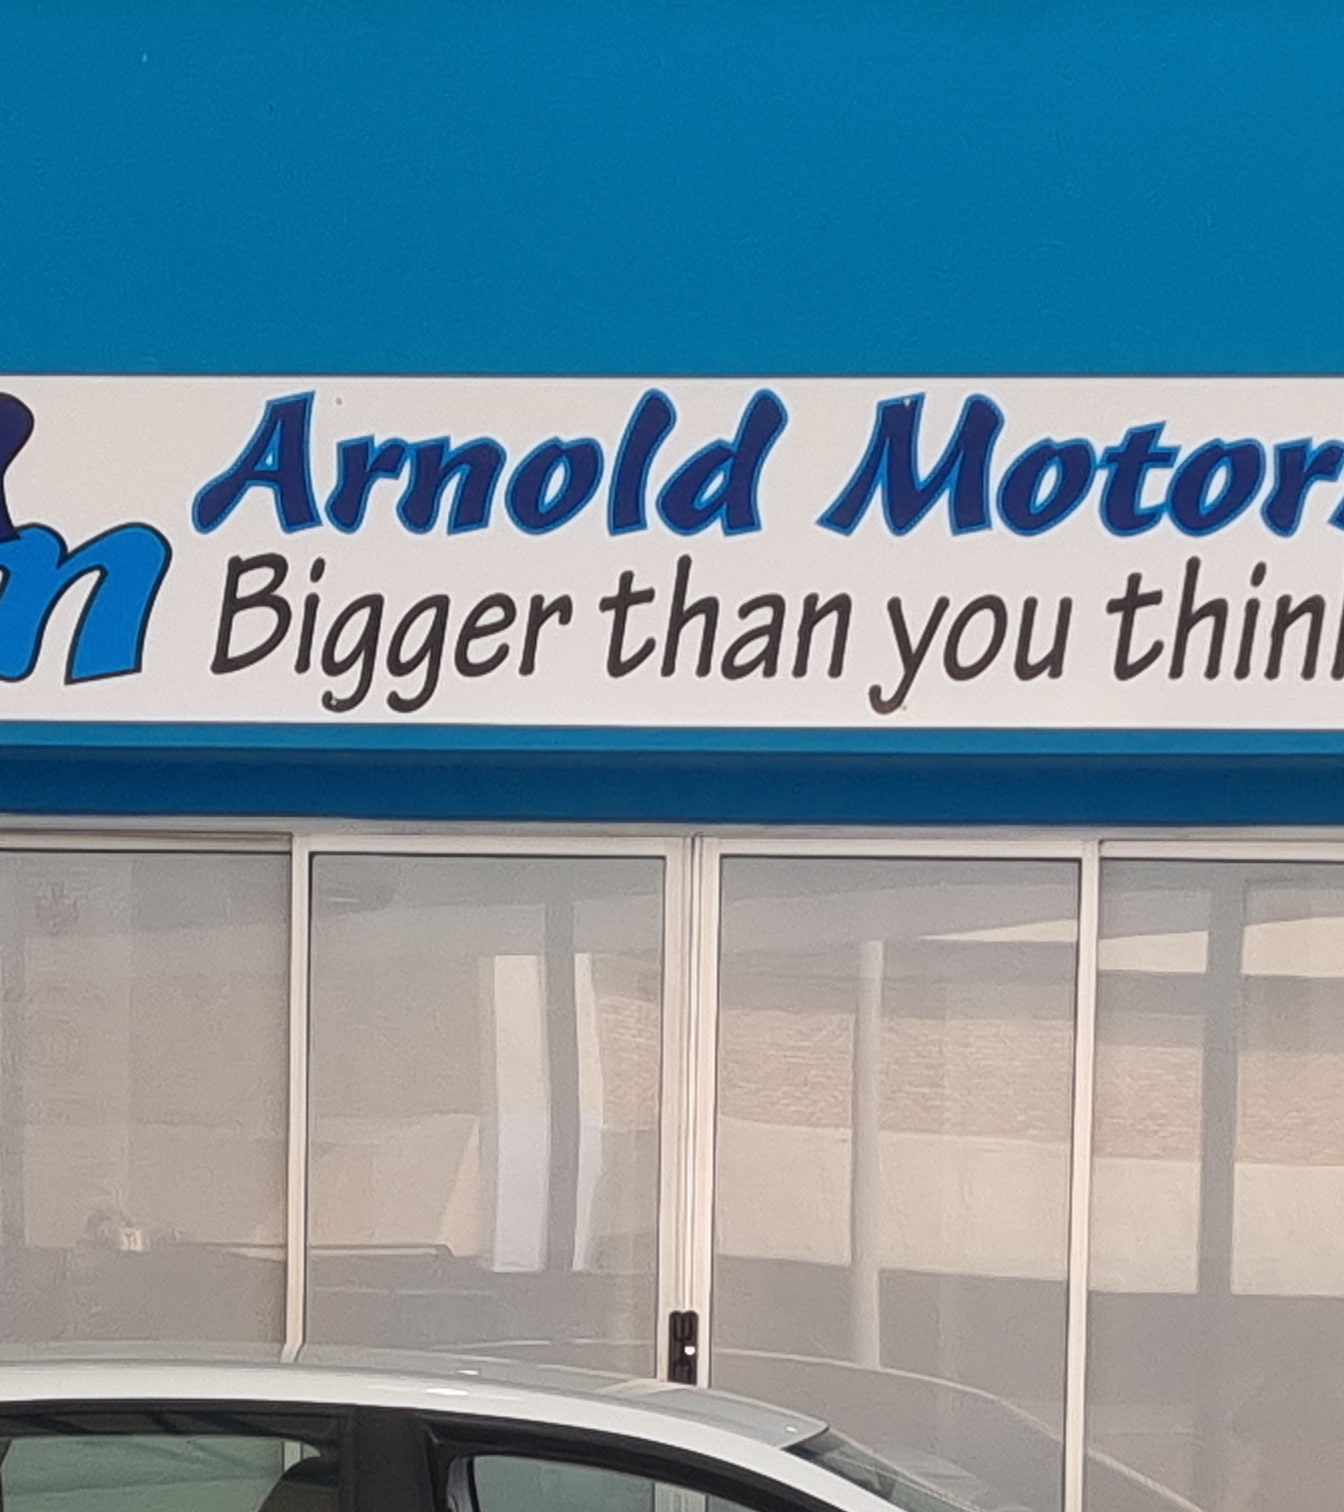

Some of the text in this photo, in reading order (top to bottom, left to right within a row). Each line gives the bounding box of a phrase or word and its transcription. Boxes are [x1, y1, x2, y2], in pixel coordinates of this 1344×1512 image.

[191, 386, 789, 537] Arnold
[210, 552, 573, 714] Bigger
[599, 554, 852, 681] than
[868, 593, 1073, 715] you
